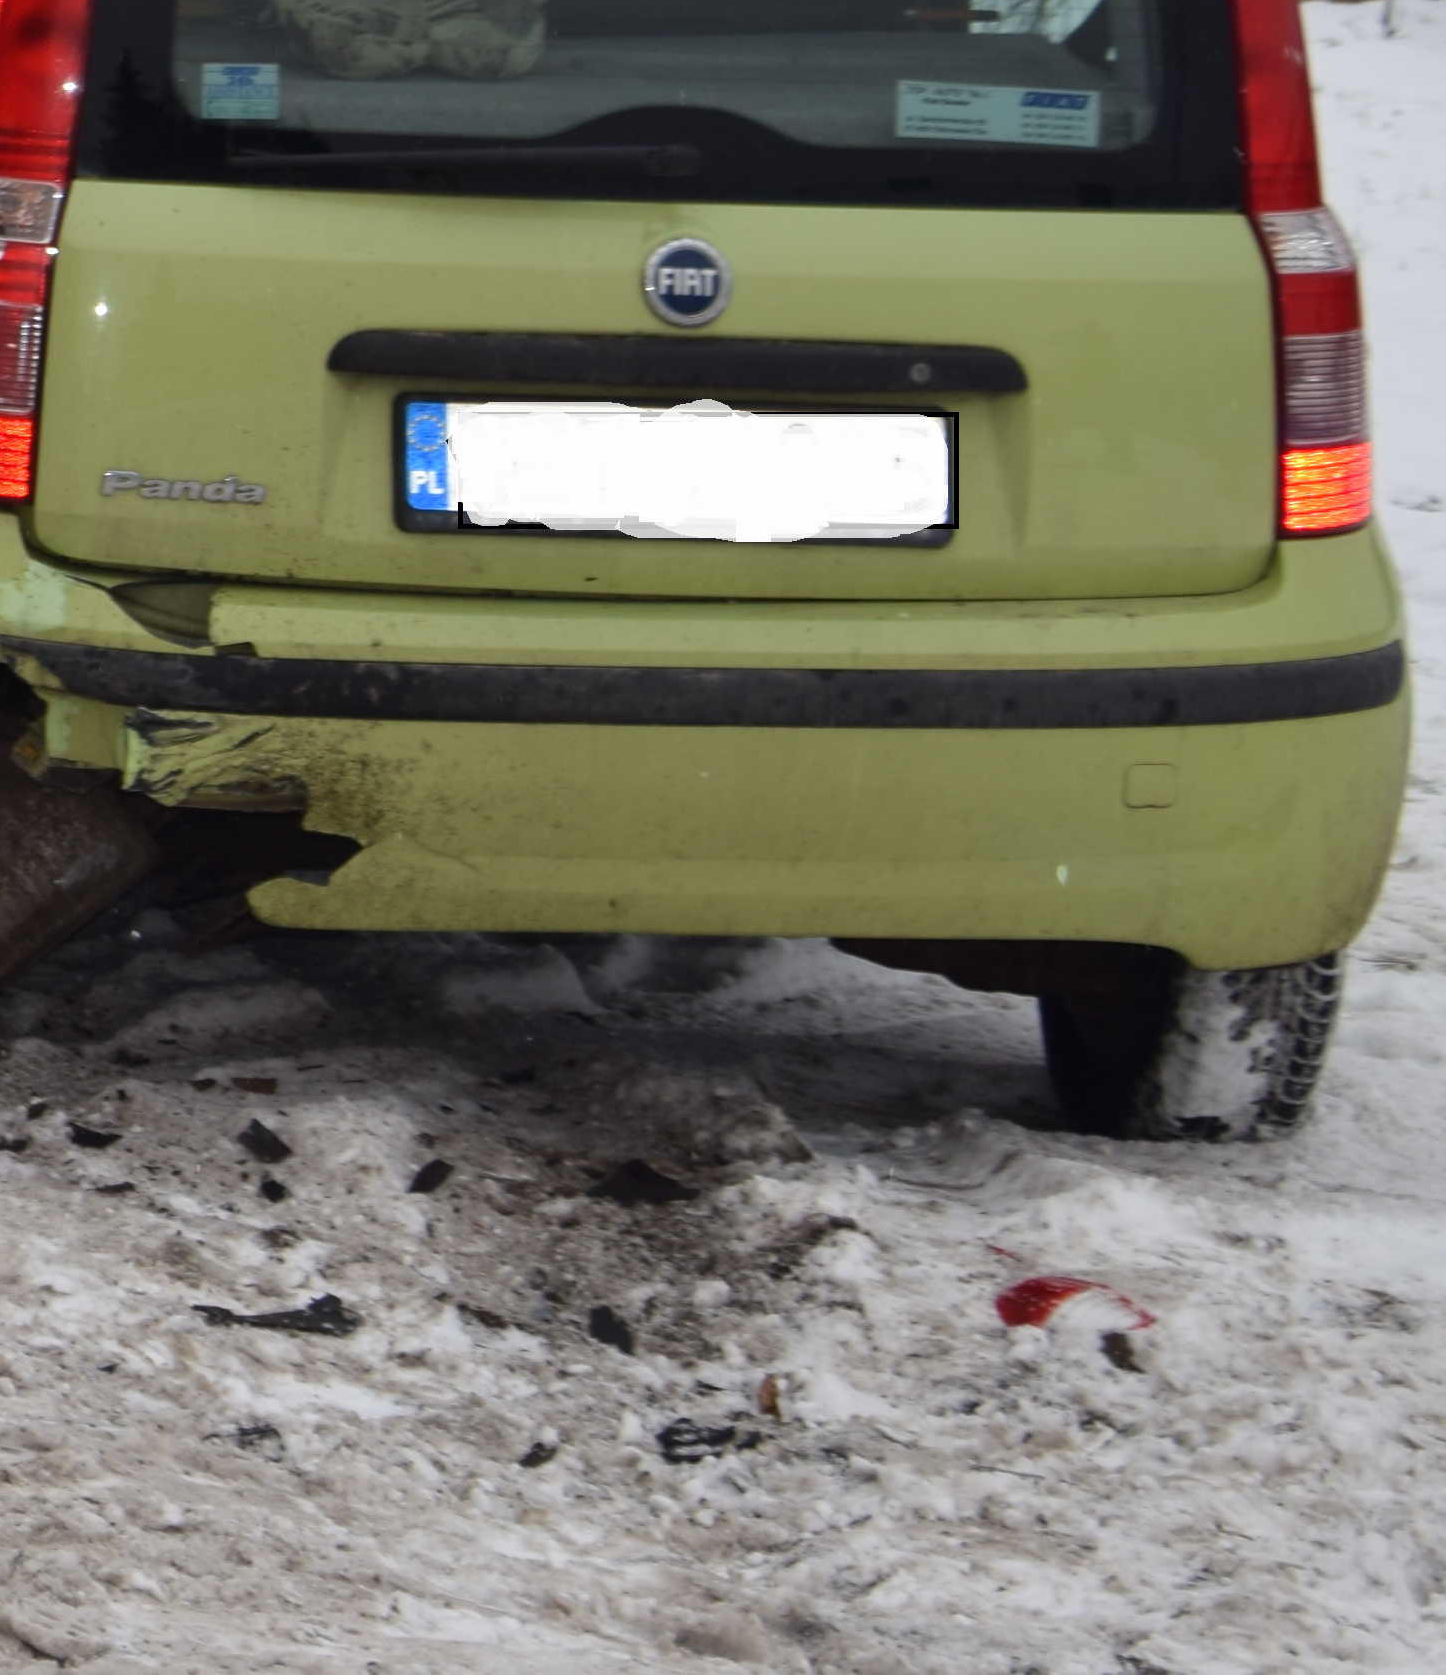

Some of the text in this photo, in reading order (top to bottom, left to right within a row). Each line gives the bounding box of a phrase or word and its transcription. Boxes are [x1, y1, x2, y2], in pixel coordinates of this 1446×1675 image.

[658, 268, 717, 296] FIAT
[101, 470, 265, 504] Panda
[410, 470, 444, 494] PL
